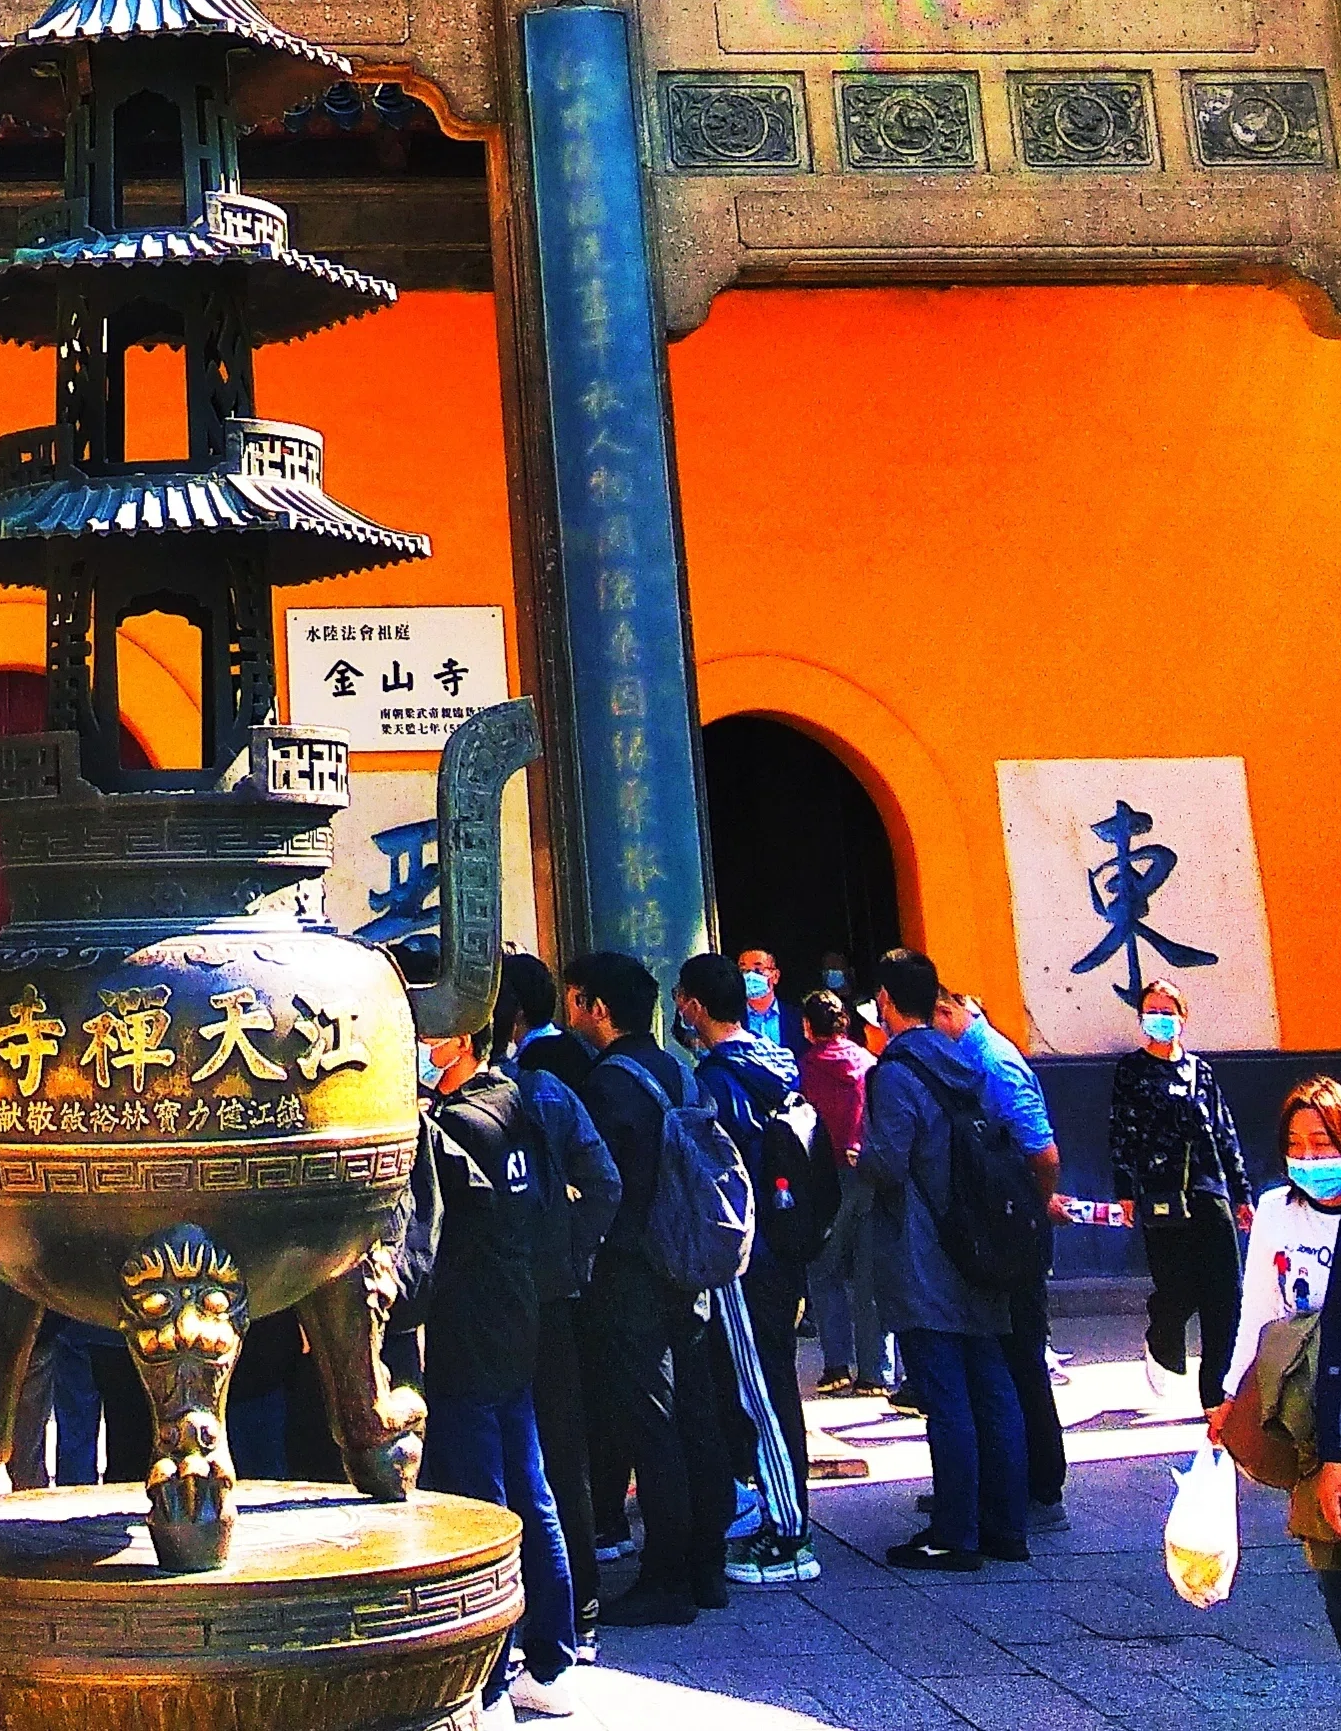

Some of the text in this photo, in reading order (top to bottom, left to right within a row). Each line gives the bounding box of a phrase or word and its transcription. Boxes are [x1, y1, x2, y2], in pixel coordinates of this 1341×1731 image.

[306, 624, 411, 642] 水陸法會祖庭
[323, 658, 470, 697] 金山寺
